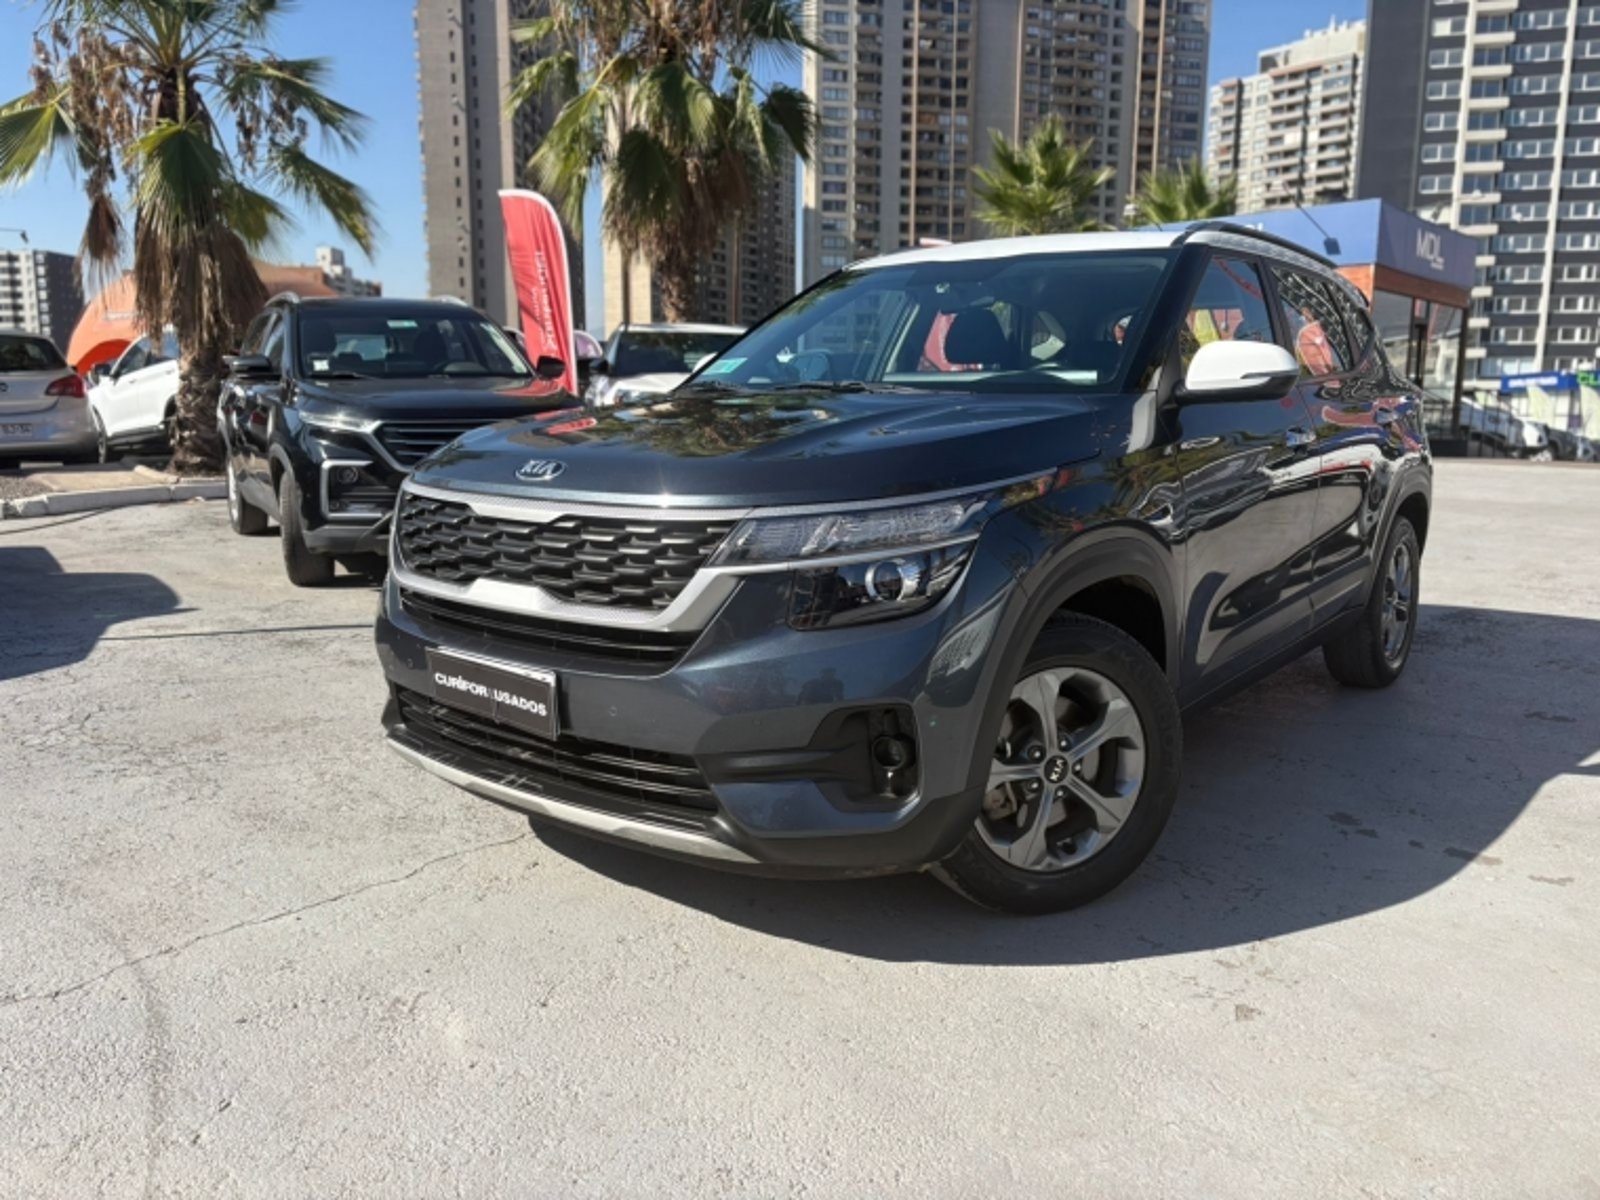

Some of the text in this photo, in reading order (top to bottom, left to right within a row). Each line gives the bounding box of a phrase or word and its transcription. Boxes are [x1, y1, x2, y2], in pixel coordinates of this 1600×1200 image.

[519, 459, 560, 477] KIA
[494, 688, 548, 717] USADOS
[1050, 759, 1064, 781] KIA
